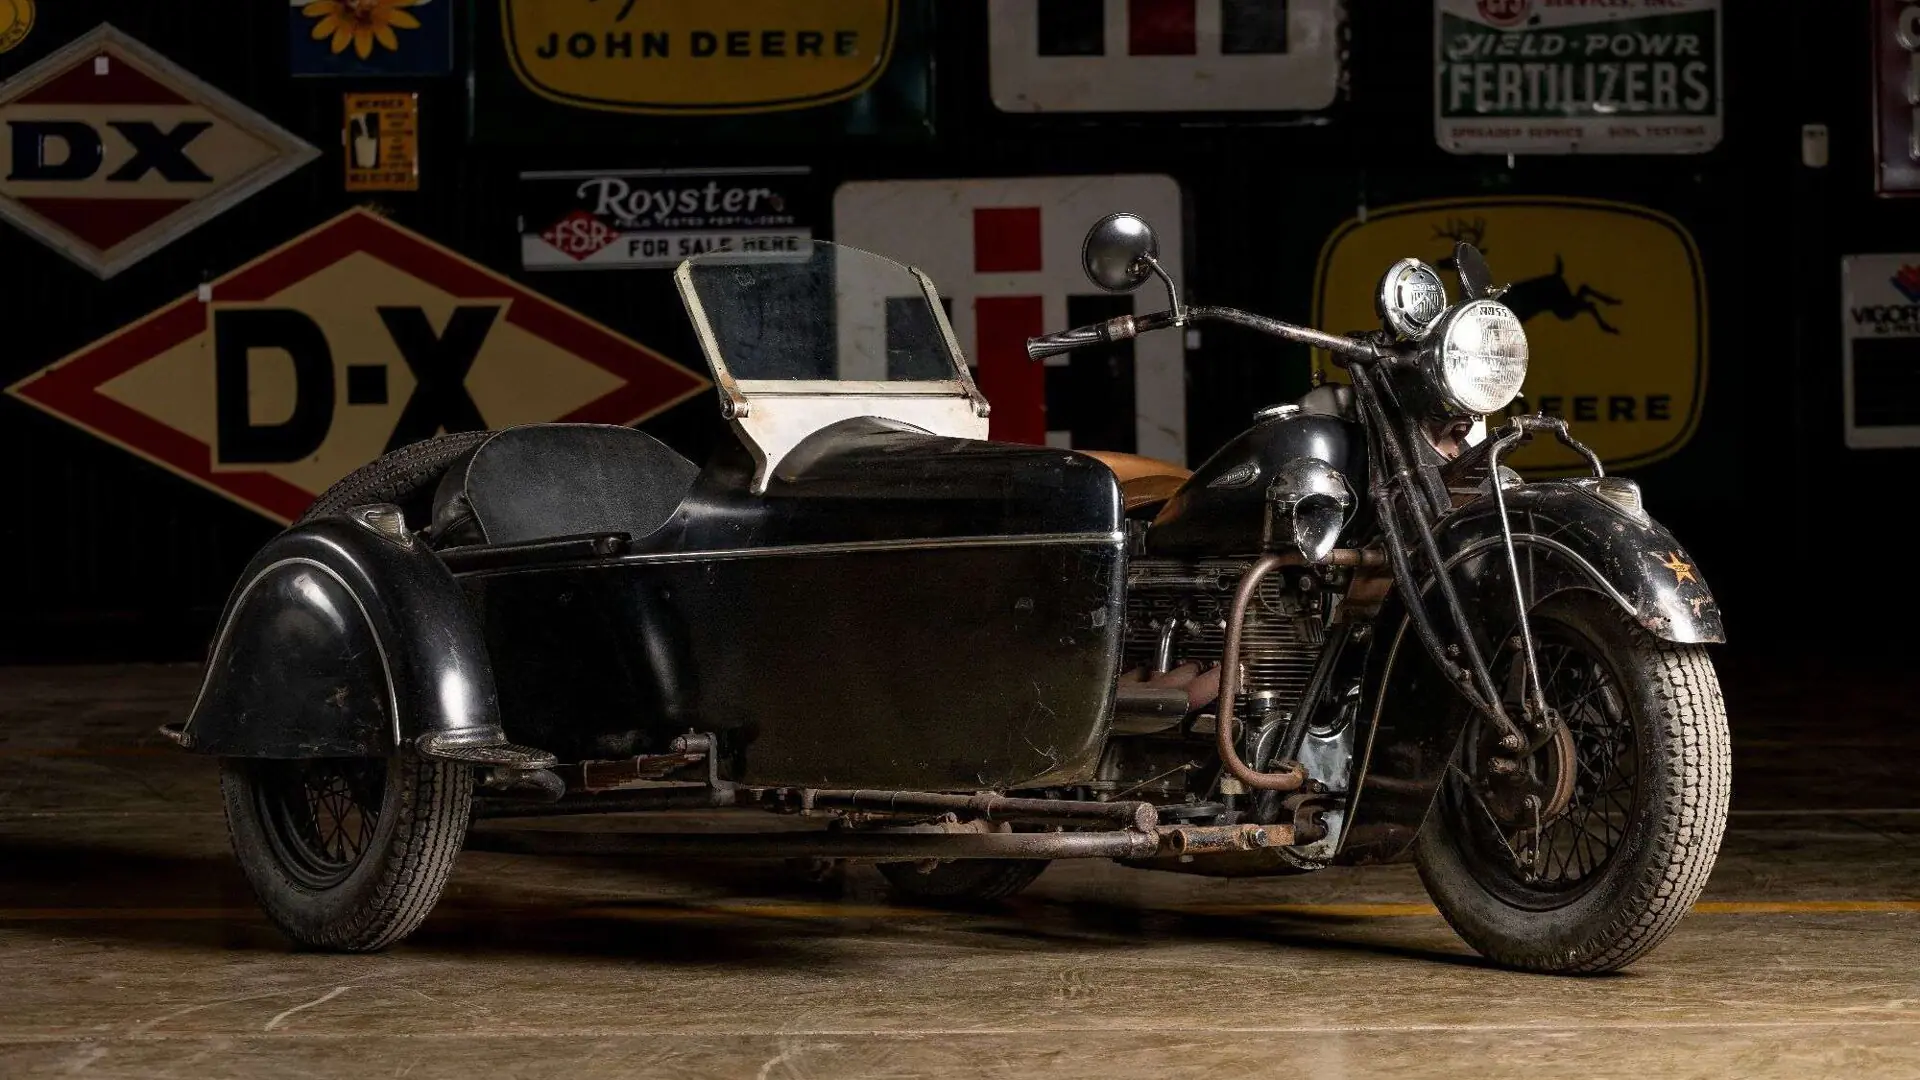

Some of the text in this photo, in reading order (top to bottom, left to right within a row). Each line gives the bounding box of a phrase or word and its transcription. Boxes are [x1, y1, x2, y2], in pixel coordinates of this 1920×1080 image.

[537, 30, 860, 59] JOHN DEERE
[1450, 60, 1711, 113] FERTILIZERS
[1452, 126, 1522, 138] SPREADER
[1529, 127, 1584, 138] SERVICE
[1646, 125, 1706, 136] TESTING
[6, 121, 214, 182] DX
[576, 178, 773, 222] Royster
[629, 235, 799, 257] FOR SALE HERE
[1851, 304, 1920, 324] VIGOR
[215, 306, 501, 463] D-X
